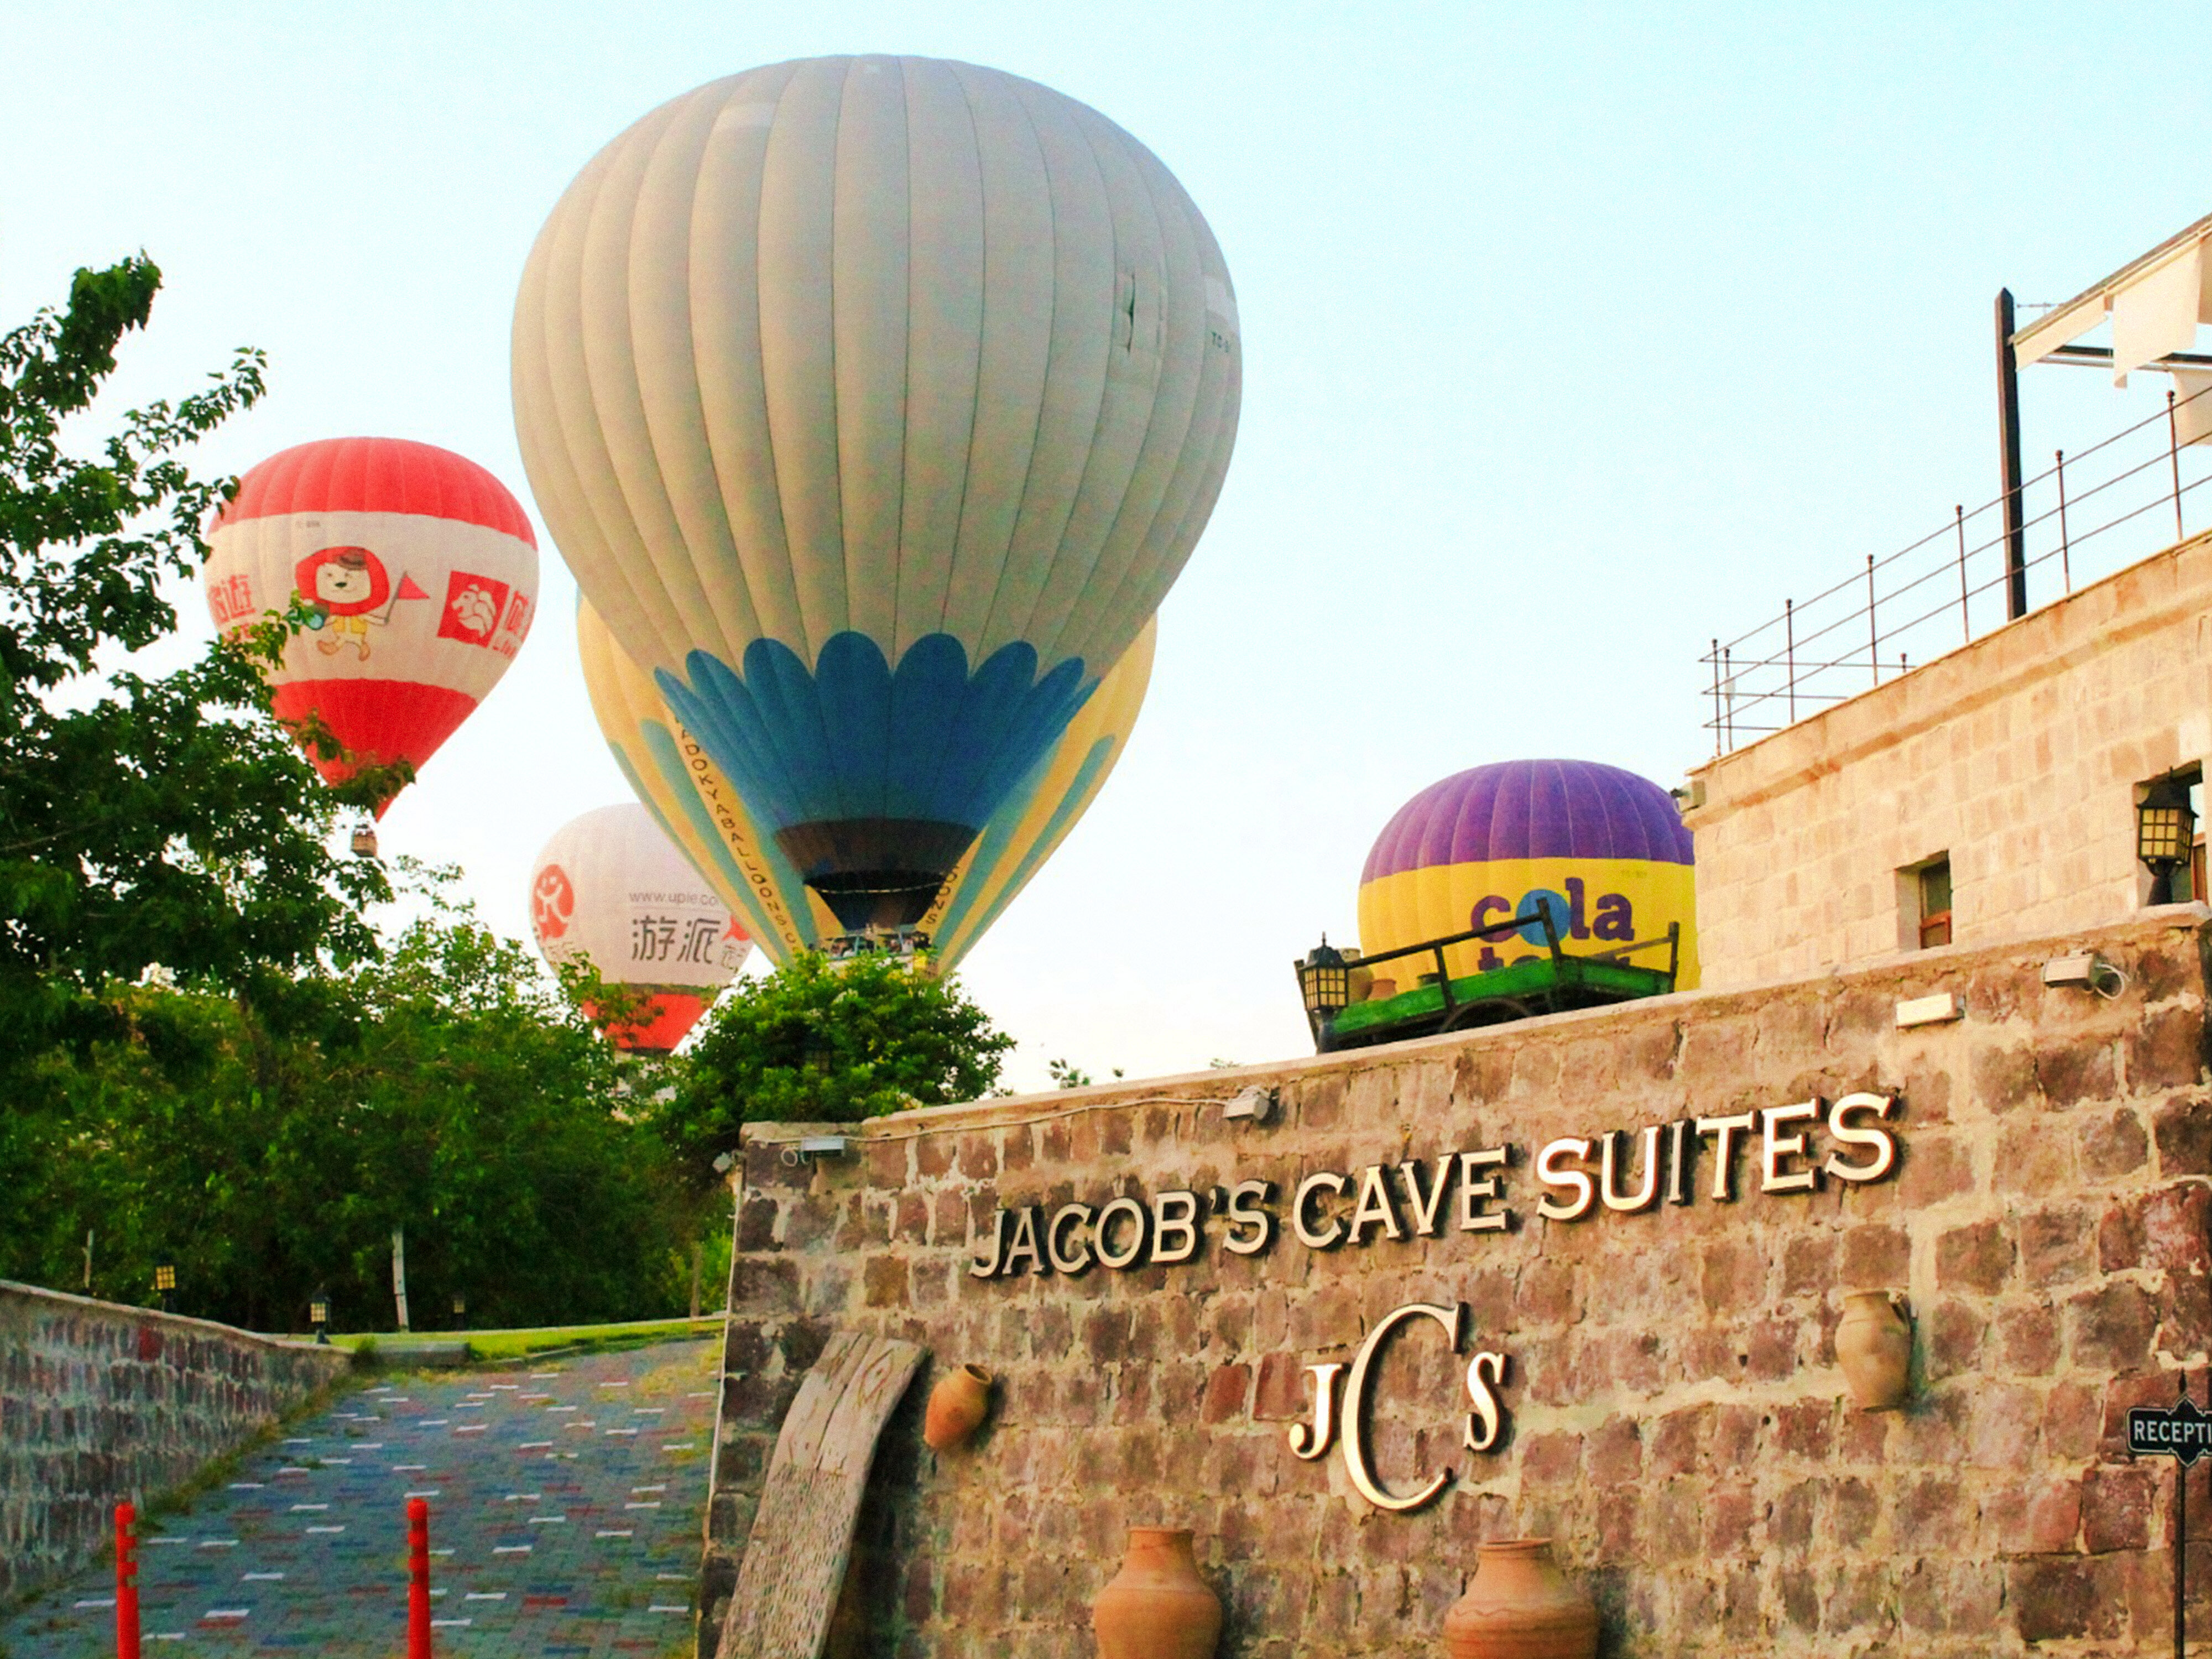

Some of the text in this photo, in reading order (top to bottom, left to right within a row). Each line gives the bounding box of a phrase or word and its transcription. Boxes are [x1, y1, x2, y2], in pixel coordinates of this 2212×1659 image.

[632, 915, 721, 964] 游派
[1470, 877, 1635, 947] cola
[969, 1092, 1896, 1279] JACOB'S CAVE SUITES
